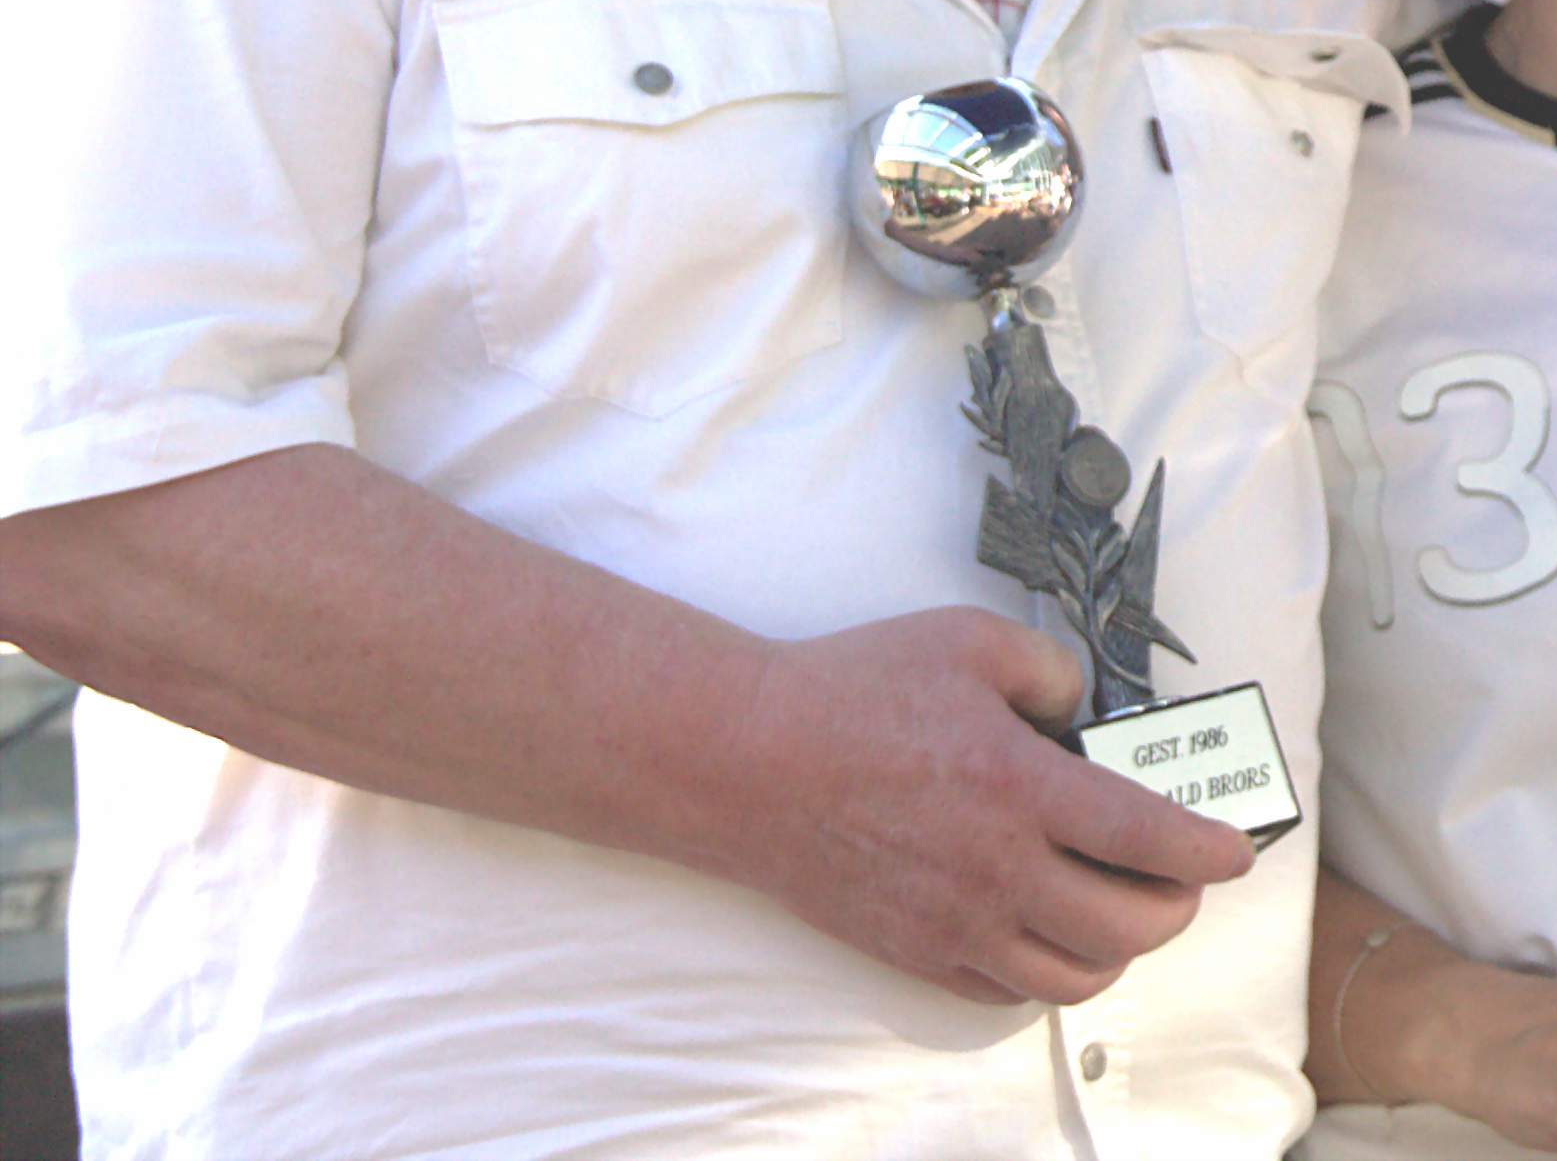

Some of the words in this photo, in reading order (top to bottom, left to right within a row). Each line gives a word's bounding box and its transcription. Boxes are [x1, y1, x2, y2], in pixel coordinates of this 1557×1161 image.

[1189, 724, 1229, 755] 1986
[1166, 781, 1202, 806] ALD
[1206, 762, 1271, 800] BRORS
